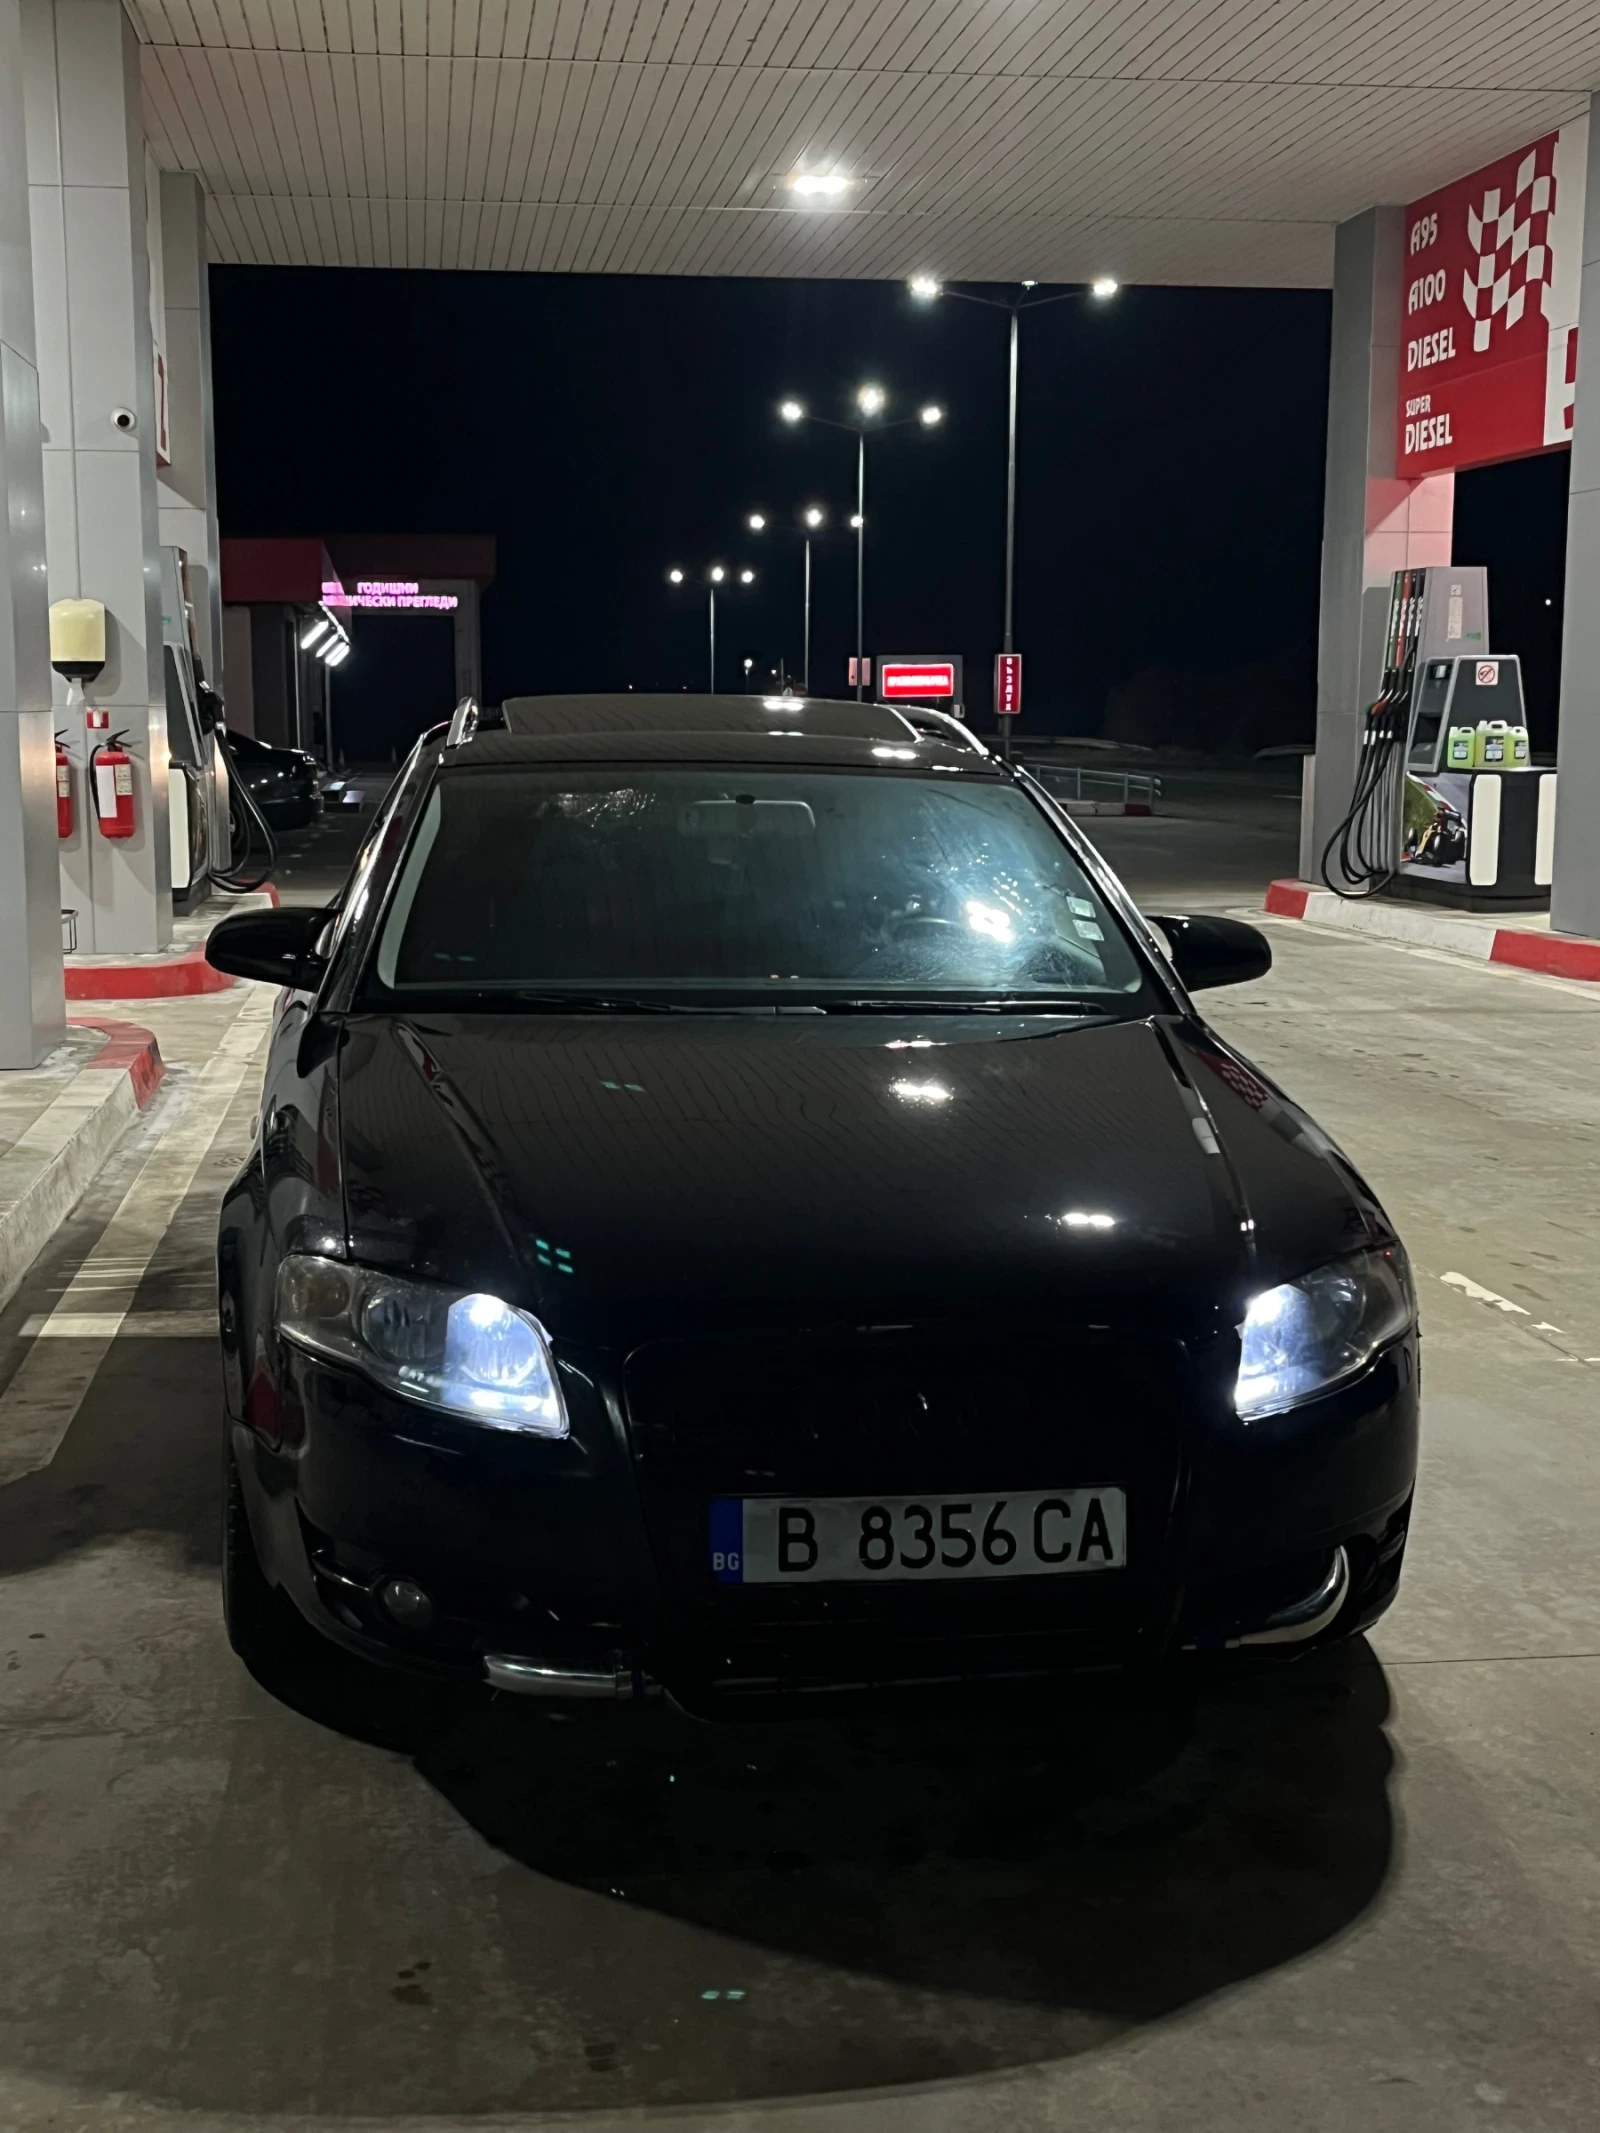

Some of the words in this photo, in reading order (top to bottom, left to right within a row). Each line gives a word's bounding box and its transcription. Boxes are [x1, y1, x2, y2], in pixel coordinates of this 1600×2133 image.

[1410, 212, 1438, 256] A95
[1408, 269, 1446, 316] A100
[1407, 327, 1456, 372] DIESEL
[1406, 394, 1431, 418] SUPER
[1405, 413, 1453, 455] DIESEL
[357, 582, 419, 595] ГОДИШНИ
[397, 596, 458, 609] ПРЕГЛЕДИ
[713, 1552, 740, 1571] BG
[778, 1506, 819, 1572] B
[858, 1500, 1017, 1571] 8356
[1033, 1497, 1114, 1563] CA
